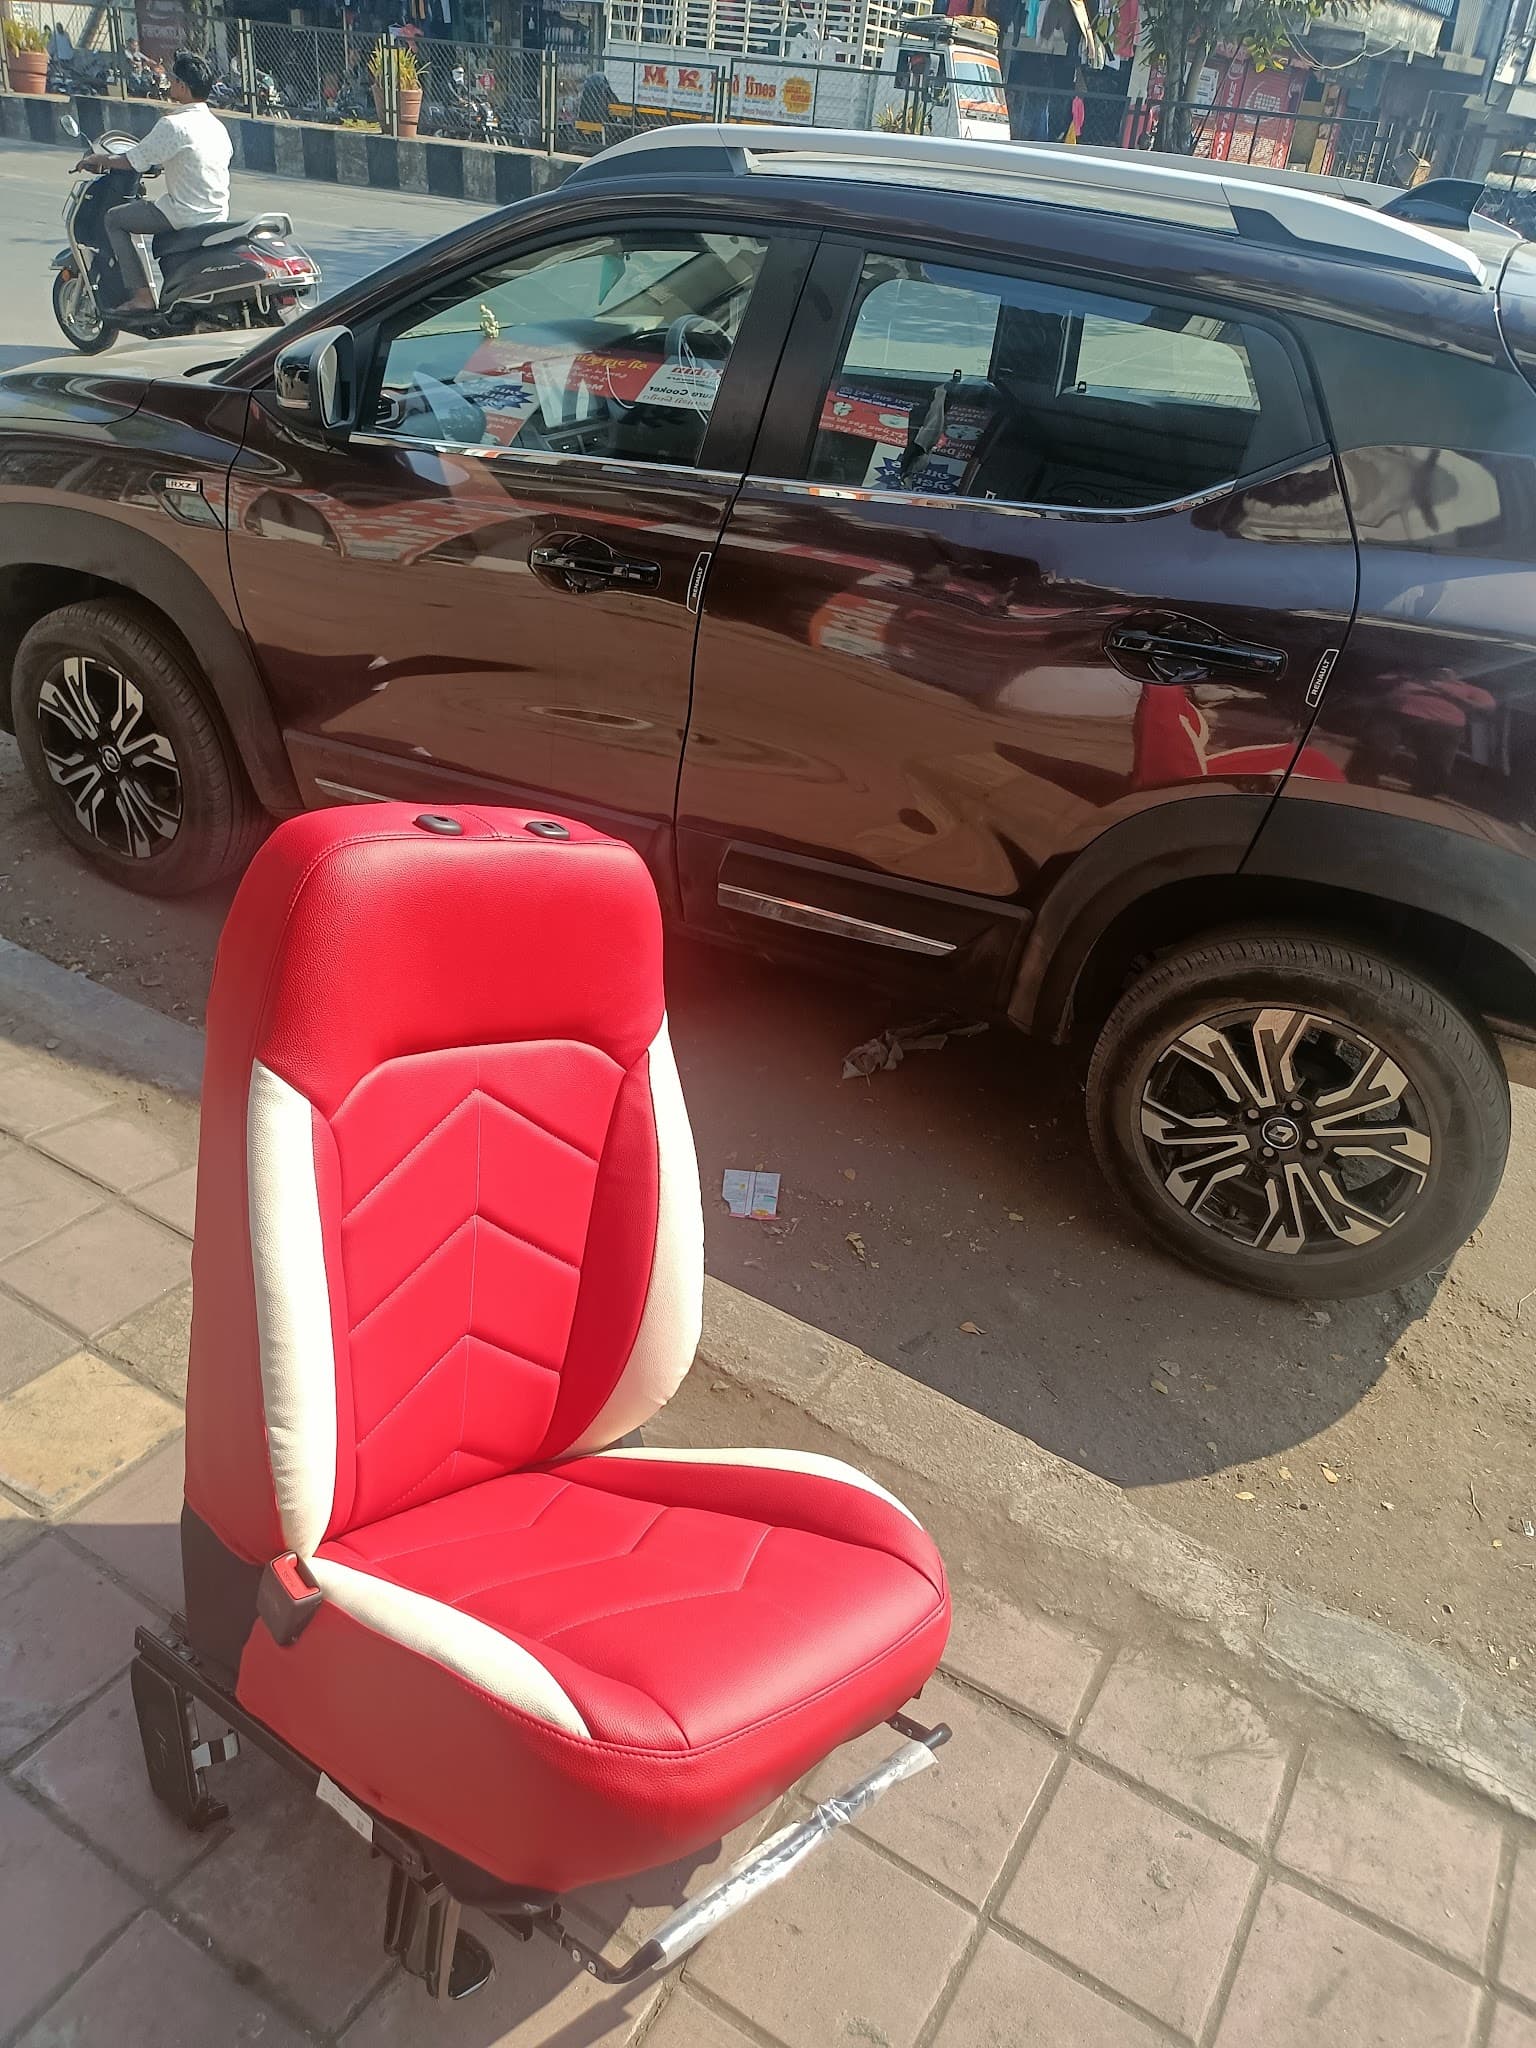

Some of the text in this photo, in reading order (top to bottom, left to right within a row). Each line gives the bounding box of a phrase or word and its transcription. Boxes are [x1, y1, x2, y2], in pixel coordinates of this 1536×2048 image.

[642, 65, 669, 86] M.
[678, 69, 703, 88] K.
[170, 480, 192, 489] RXZ
[691, 566, 704, 598] RENAULT
[1311, 658, 1330, 696] RENAULT
